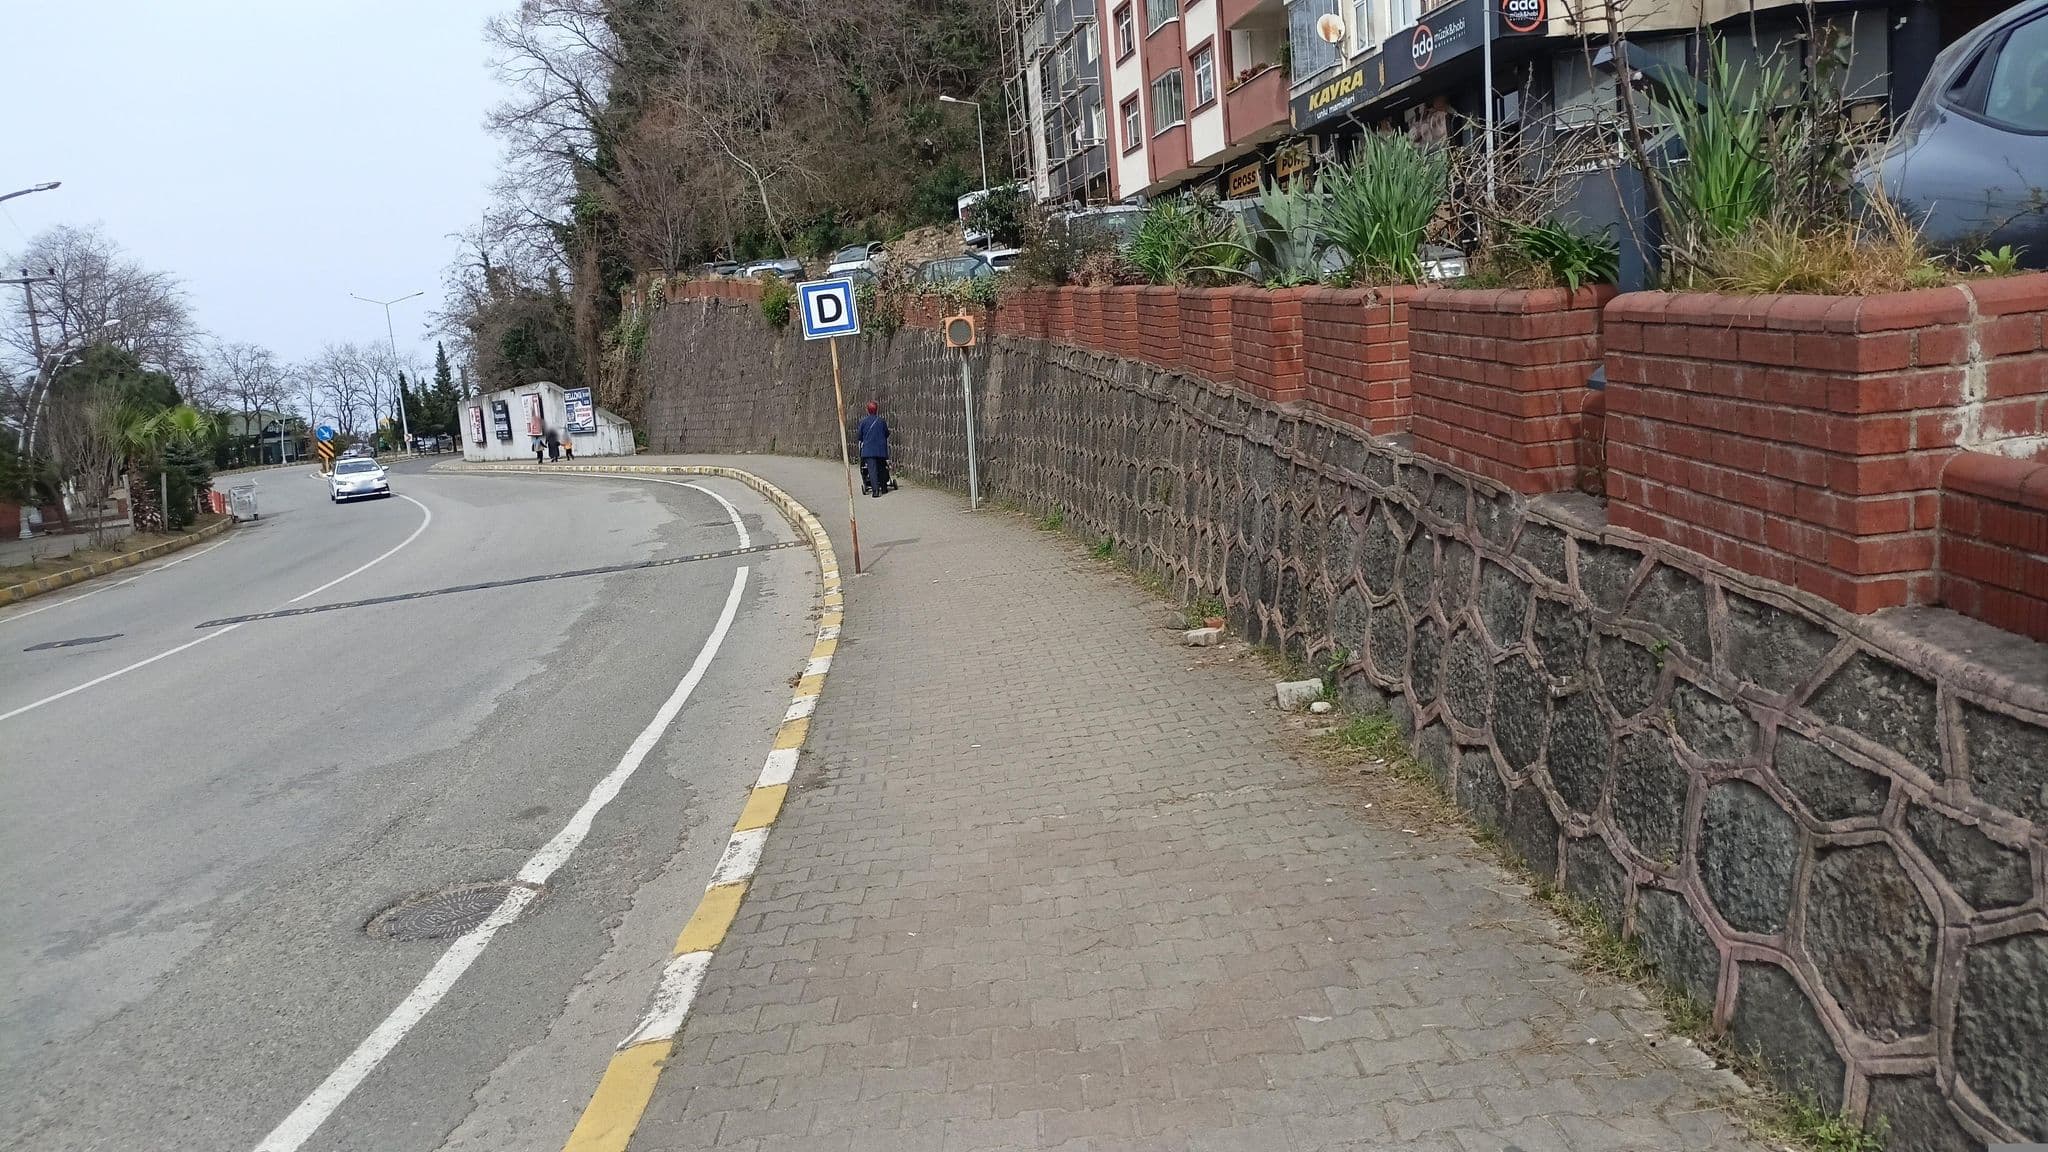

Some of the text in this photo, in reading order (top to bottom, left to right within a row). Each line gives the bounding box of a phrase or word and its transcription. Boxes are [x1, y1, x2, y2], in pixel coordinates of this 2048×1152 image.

[1412, 34, 1433, 59] ada
[1309, 69, 1364, 112] KAVRA
[1232, 171, 1256, 190] CROSS
[816, 293, 842, 323] D
